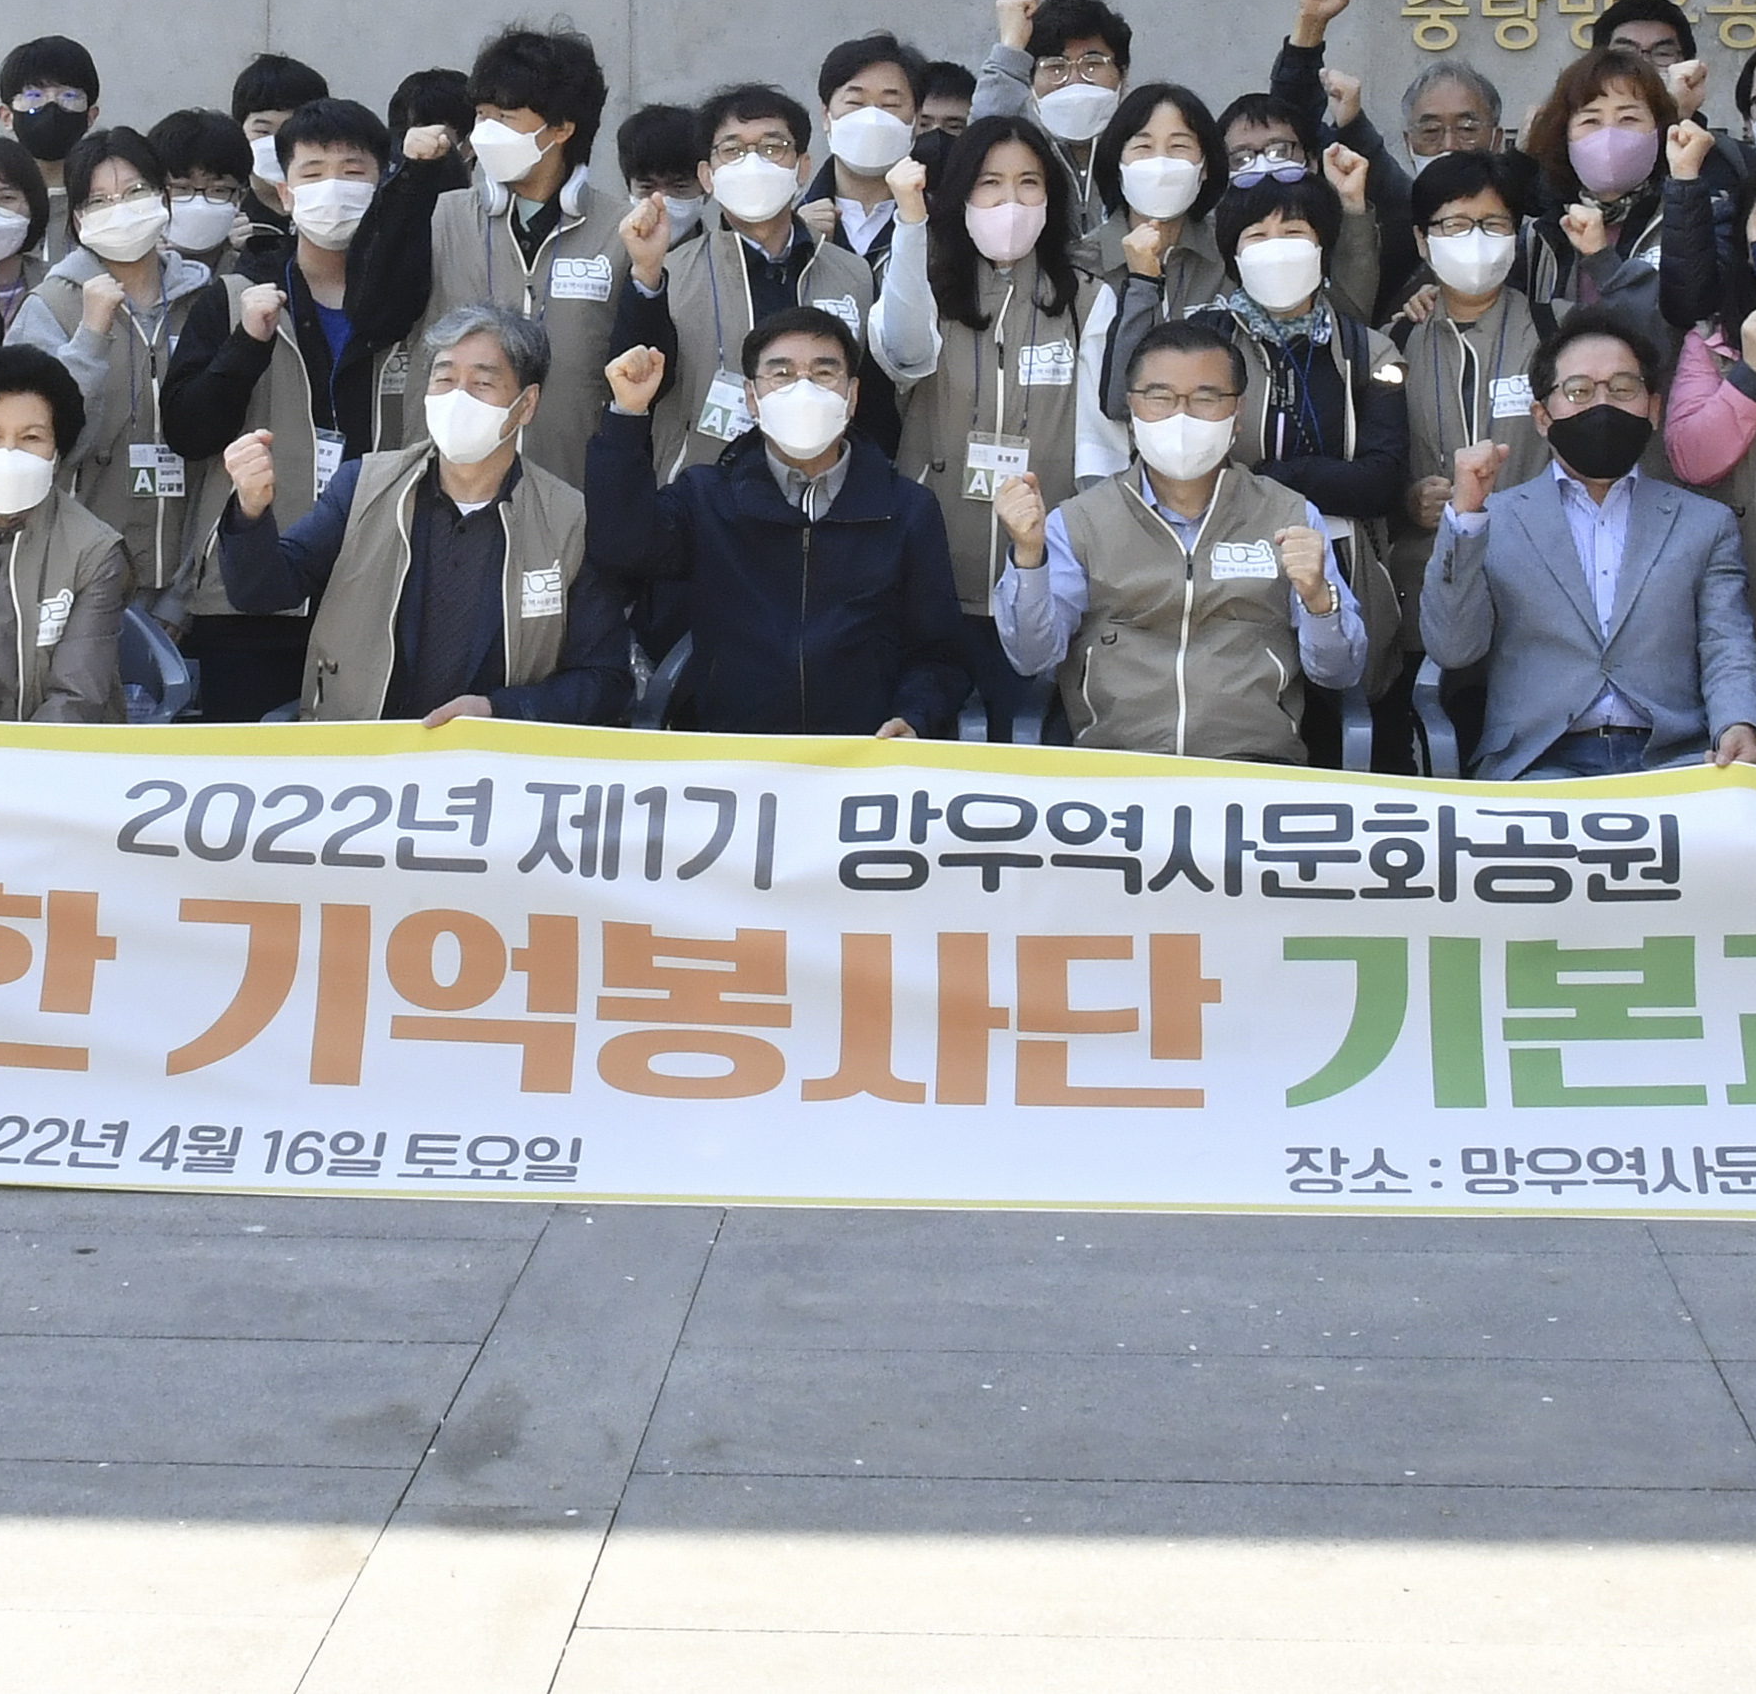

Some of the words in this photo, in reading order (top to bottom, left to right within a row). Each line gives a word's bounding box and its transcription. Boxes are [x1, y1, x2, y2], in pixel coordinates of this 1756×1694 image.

[133, 468, 153, 492] A
[968, 469, 992, 497] A
[116, 777, 494, 875] 2022년
[517, 781, 779, 892] 제1기
[838, 790, 1683, 904] 망우역사문화공원
[165, 897, 1223, 1109] 기억봉사단
[137, 1123, 244, 1175] 4월
[262, 1128, 387, 1178] 16일
[396, 1134, 584, 1184] 토요일
[1284, 1144, 1412, 1197] 장소
